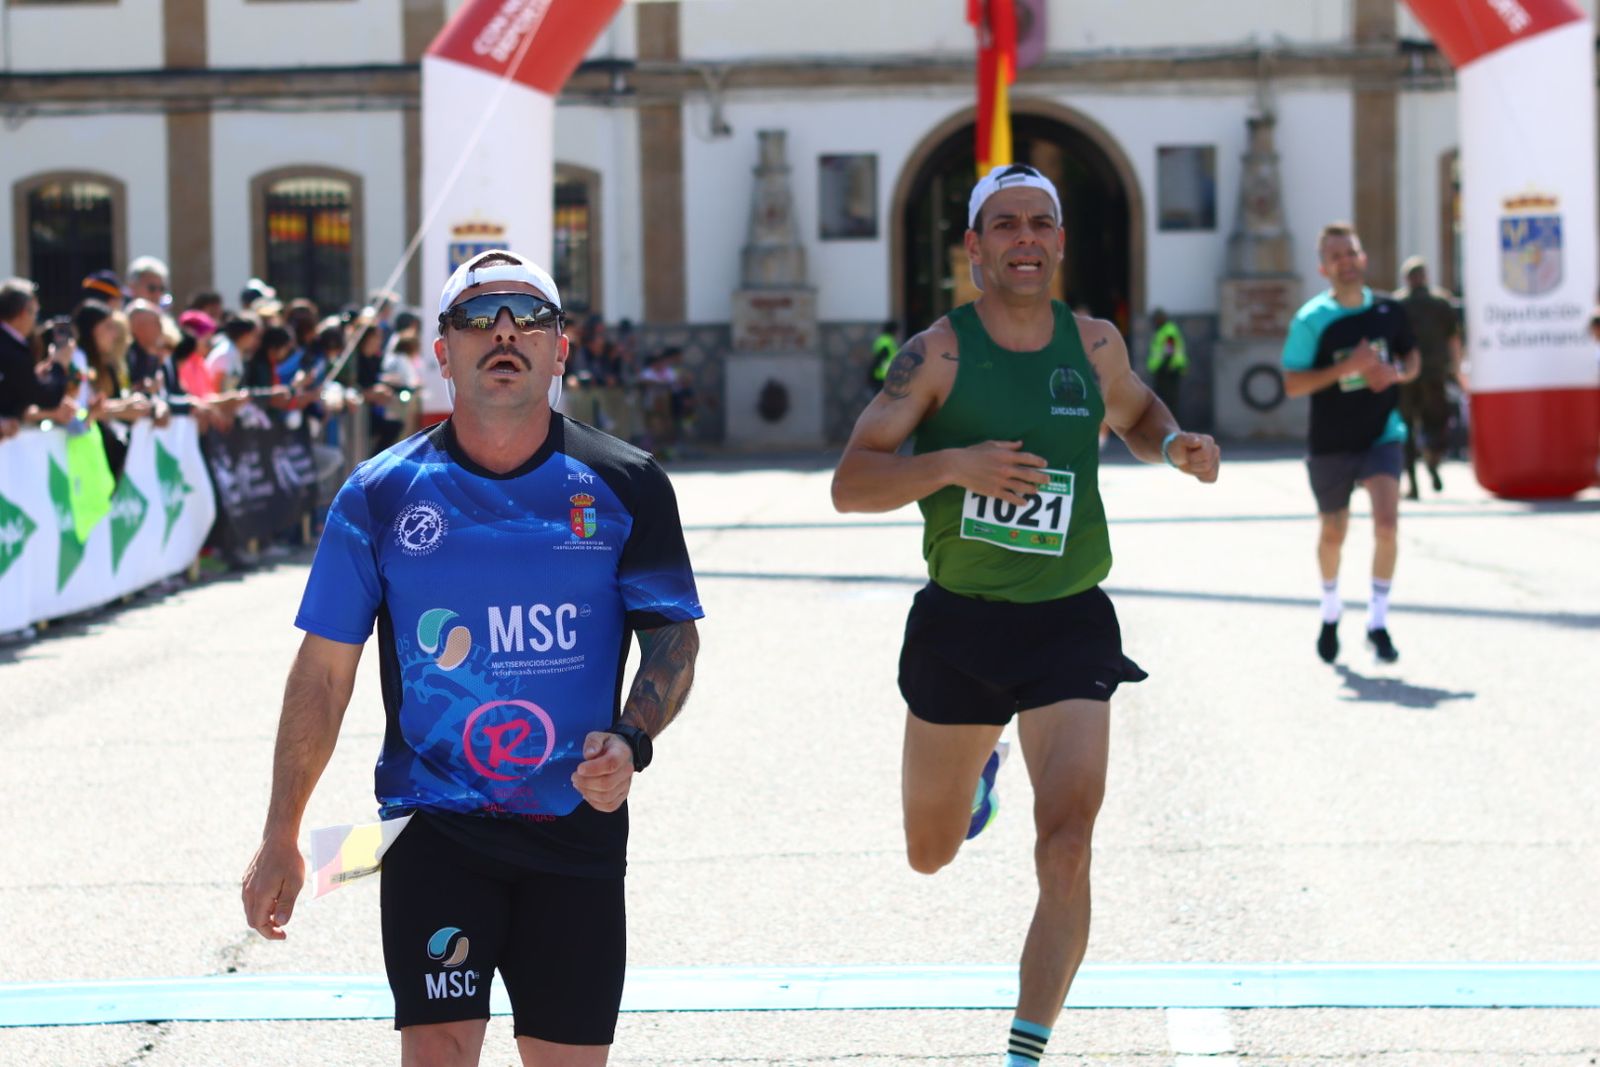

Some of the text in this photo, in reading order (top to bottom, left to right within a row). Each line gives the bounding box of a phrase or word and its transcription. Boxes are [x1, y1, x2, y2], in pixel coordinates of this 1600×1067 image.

[971, 493, 1063, 529] 1021
[488, 603, 577, 653] MSC
[425, 970, 476, 999] MSC
